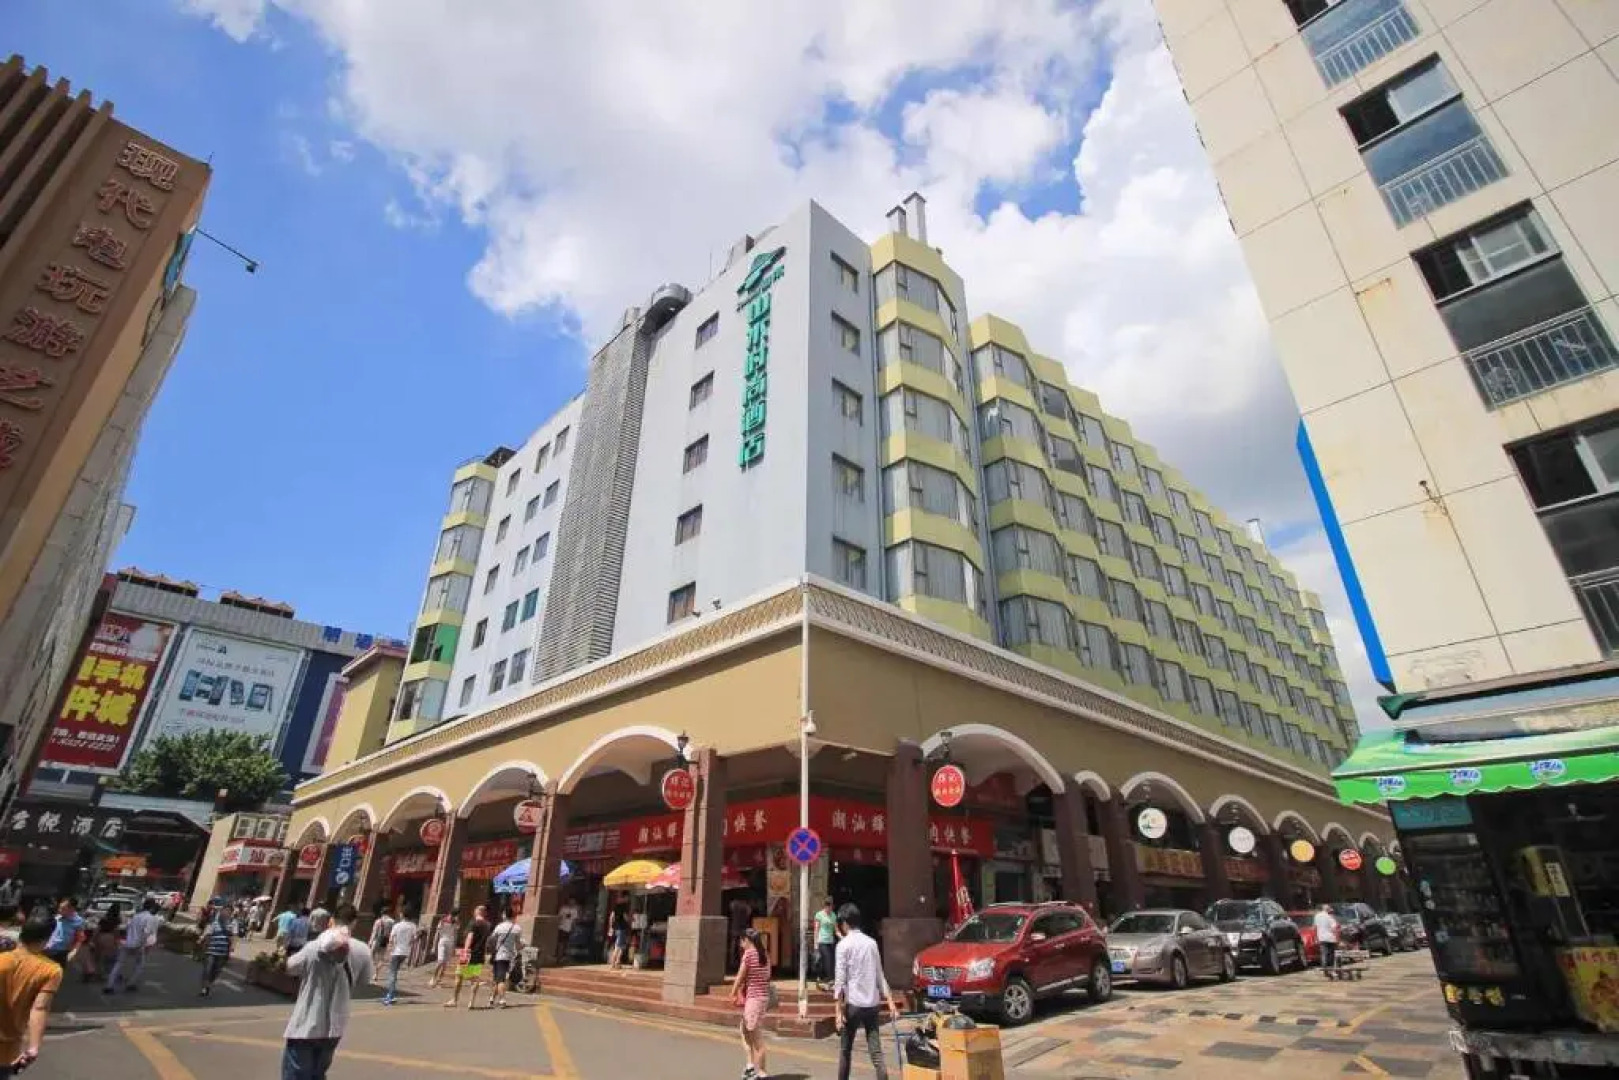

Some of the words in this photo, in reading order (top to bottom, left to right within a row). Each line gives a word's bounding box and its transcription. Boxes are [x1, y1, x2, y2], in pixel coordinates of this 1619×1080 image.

[739, 292, 772, 472] 山水时尚酒店
